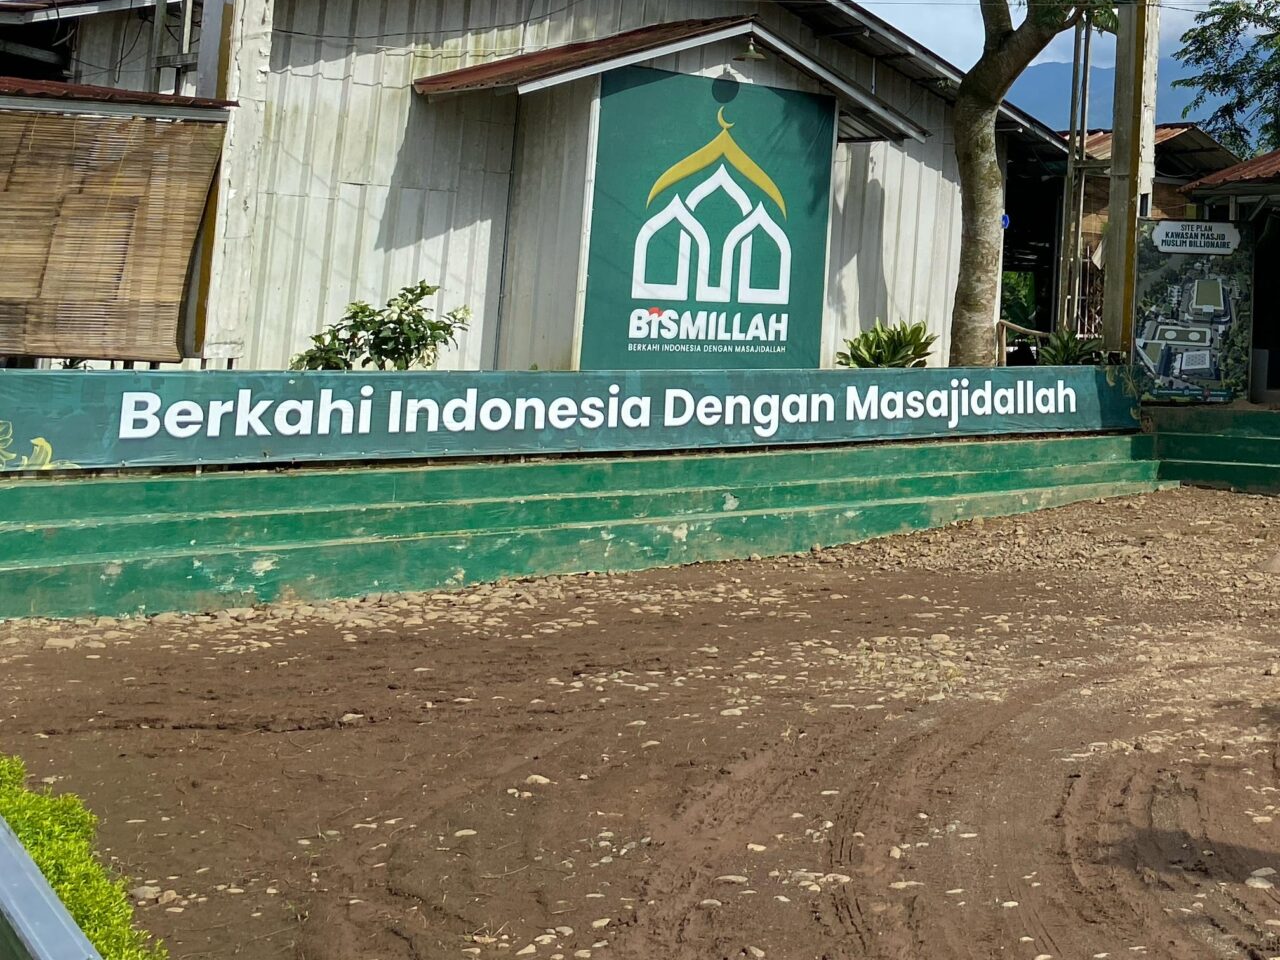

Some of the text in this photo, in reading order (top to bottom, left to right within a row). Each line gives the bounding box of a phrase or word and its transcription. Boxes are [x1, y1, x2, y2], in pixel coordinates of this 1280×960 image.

[1181, 224, 1213, 233] SITE PLAN
[1165, 231, 1226, 241] KAWASAN MASJID
[1161, 239, 1231, 249] MUSLIM BILLIONAIRE
[628, 343, 786, 353] BERKAHI INDONESIA DENGAN MASAJIDALLAH
[118, 378, 1077, 440] Berkahi Indonesia Dengan Masajidallah
